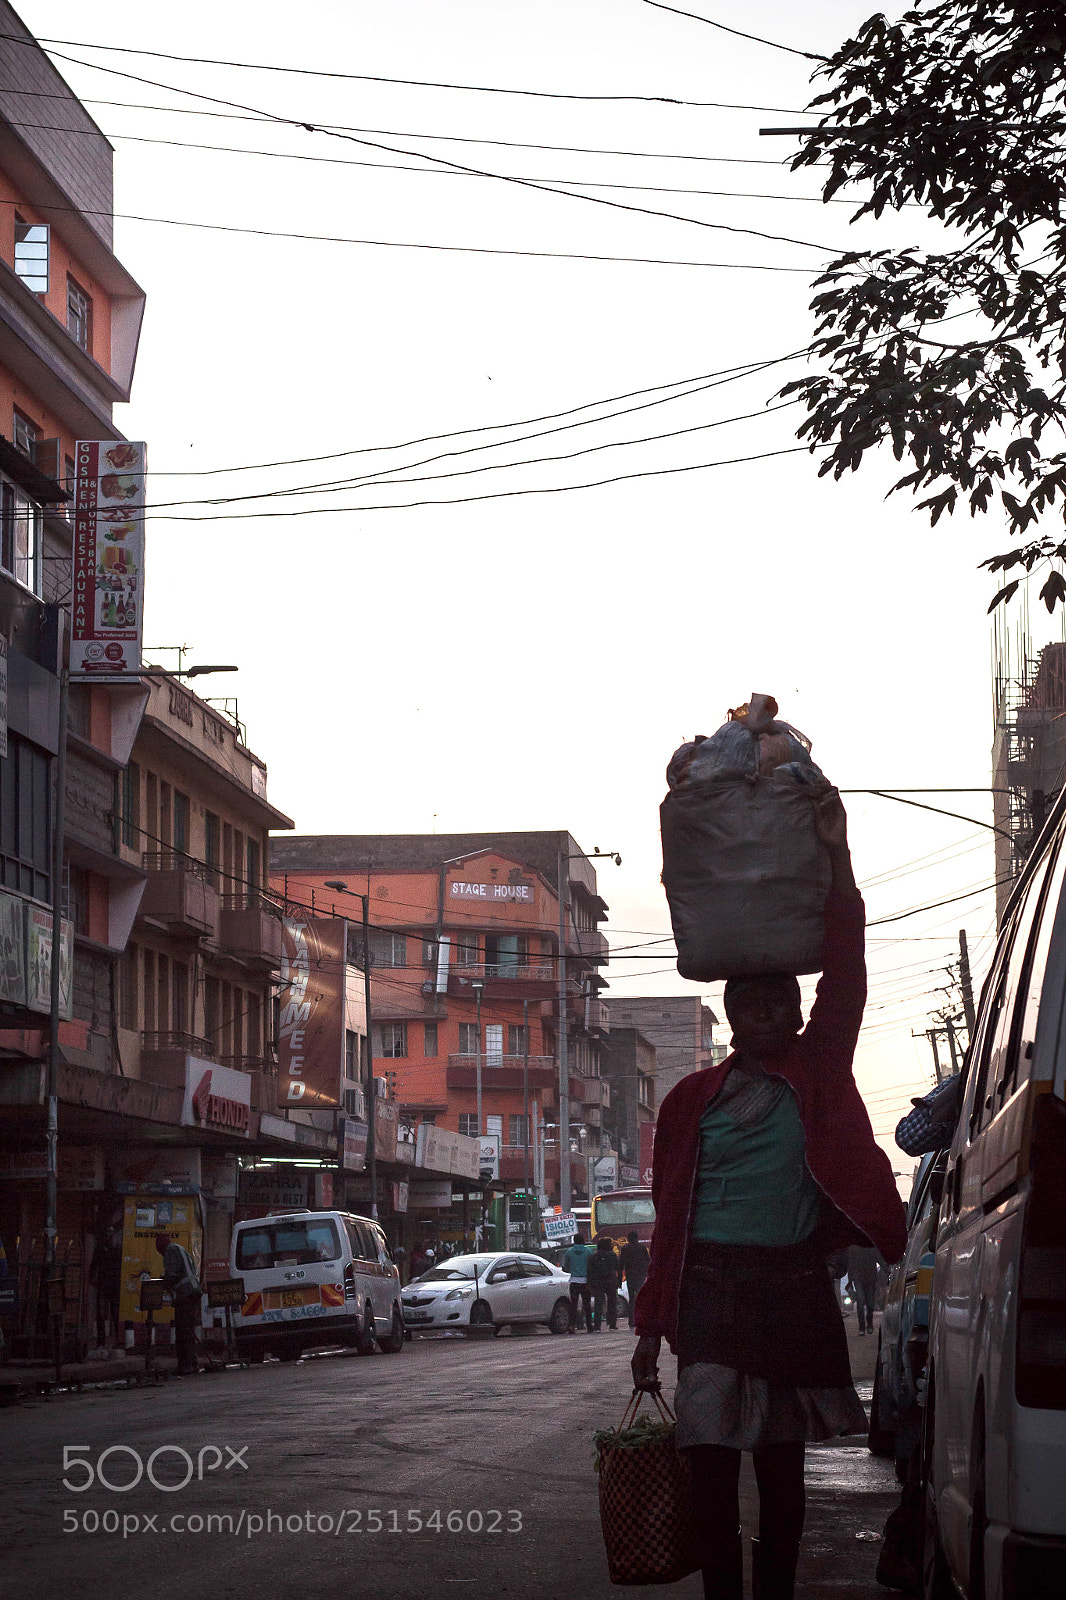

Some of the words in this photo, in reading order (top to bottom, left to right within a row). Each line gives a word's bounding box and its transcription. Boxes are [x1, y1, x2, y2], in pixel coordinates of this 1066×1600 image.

[79, 443, 90, 511] GOSHEN
[89, 480, 97, 488] &
[88, 491, 96, 547] SPORTS
[87, 549, 95, 576] BAR
[75, 521, 88, 639] RESTAURANT
[452, 882, 487, 896] STAGE
[494, 885, 529, 898] HOUSE
[286, 923, 312, 1100] TAHMEED
[210, 1094, 250, 1130] HONDA
[545, 1220, 575, 1232] ISIOLO
[547, 1228, 575, 1237] DIRECT
